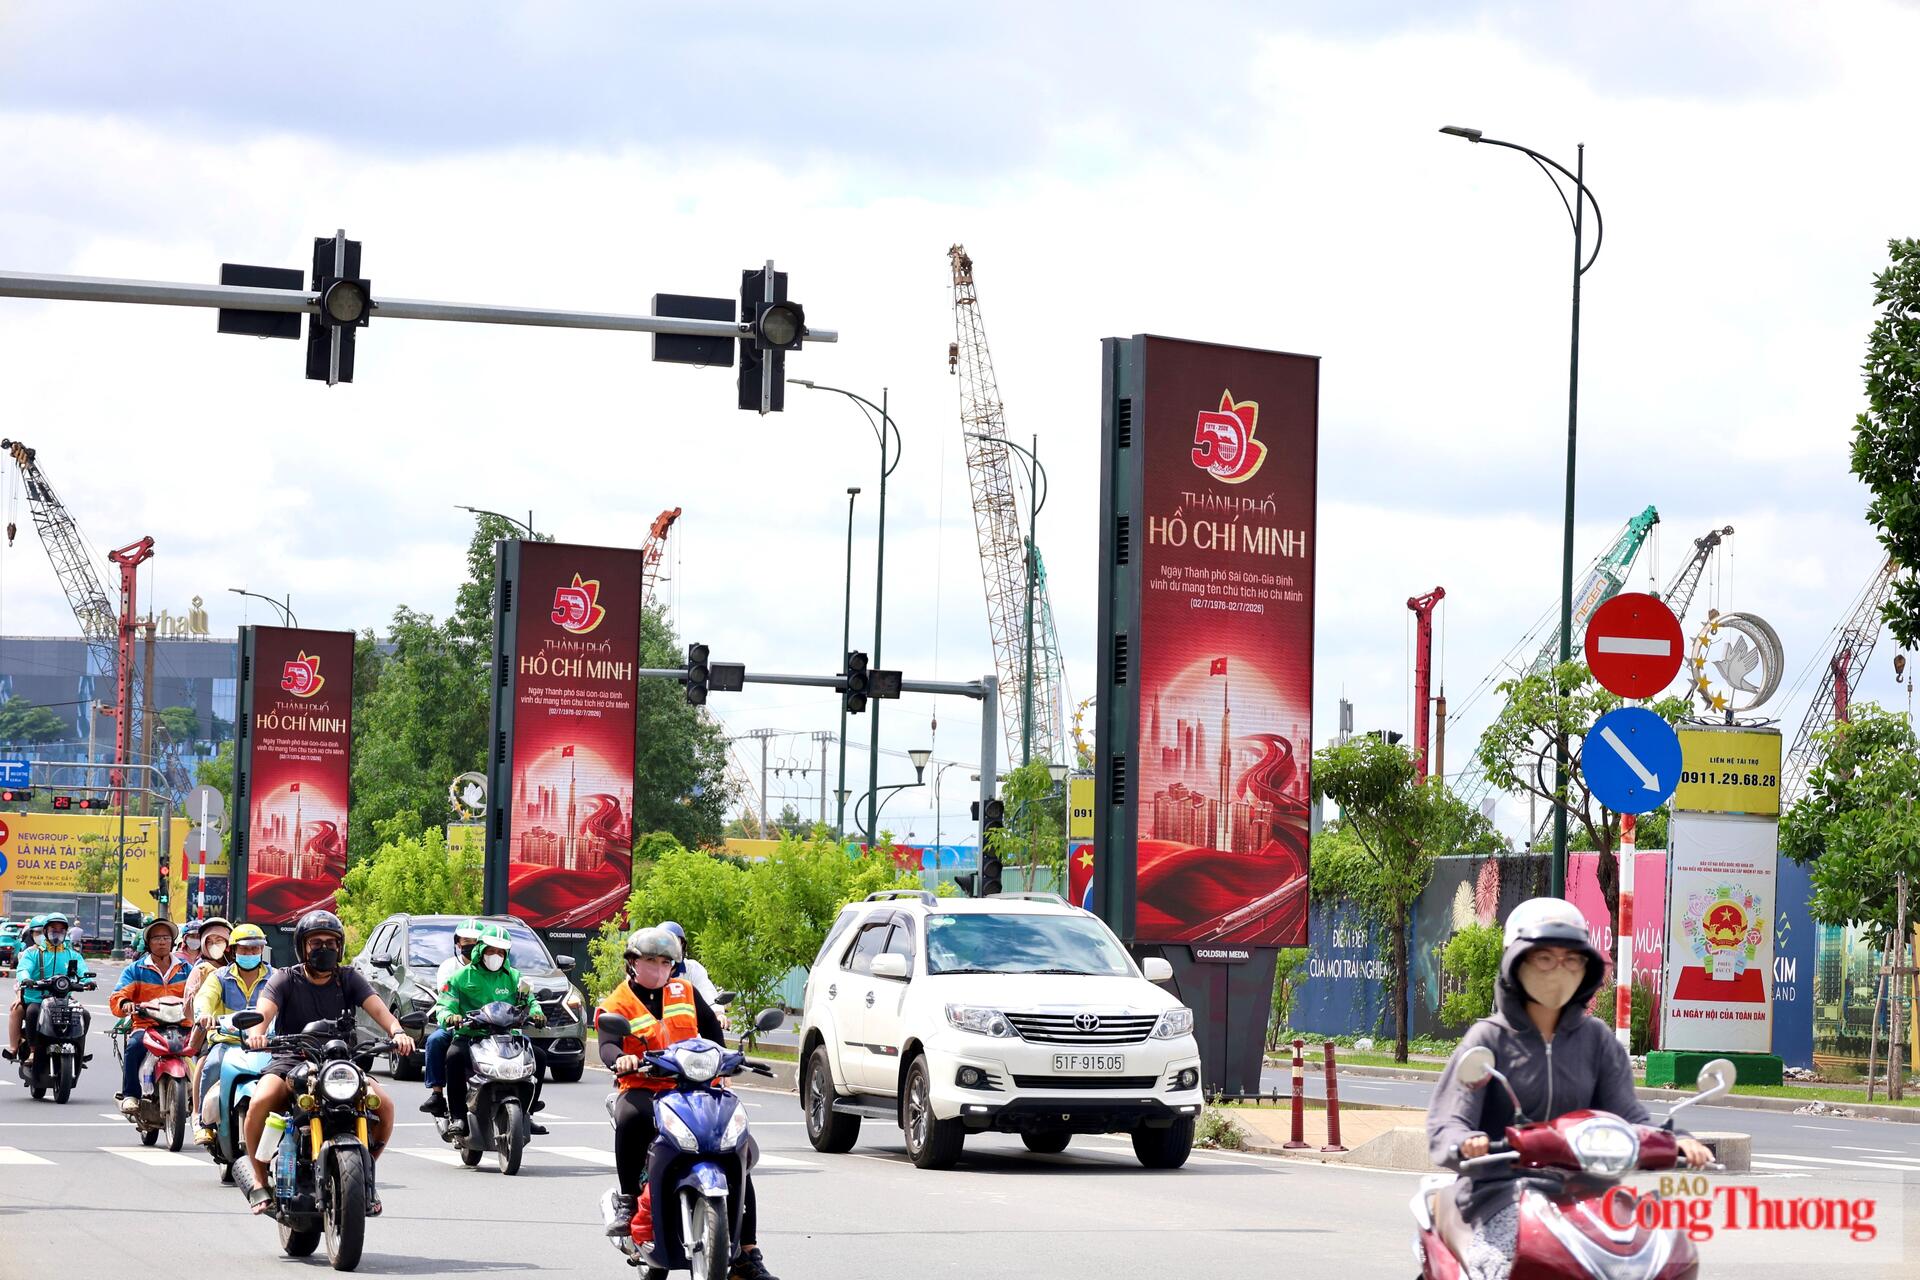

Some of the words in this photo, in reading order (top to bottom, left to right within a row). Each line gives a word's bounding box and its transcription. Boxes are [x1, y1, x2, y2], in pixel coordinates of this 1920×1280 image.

[1181, 488, 1239, 513] THÀNH
[1242, 492, 1276, 516] PHỐ
[1150, 506, 1187, 547] HỒ
[1193, 515, 1239, 551] CHÍ
[1243, 525, 1305, 558] MINH
[1275, 575, 1293, 587] Định
[1182, 583, 1205, 596] mang
[1284, 590, 1303, 602] Minh
[544, 637, 585, 652] THÀNH
[586, 639, 611, 655] PHỐ
[520, 649, 547, 675] HỒ
[552, 654, 585, 678] CHÍ
[586, 661, 632, 681] MINH
[257, 709, 279, 729] HỒ
[281, 712, 308, 731] CHÍ
[309, 717, 346, 733] MINH
[1681, 771, 1776, 787] 0911.29.68.28
[18, 833, 68, 841] NEWGROUP
[18, 843, 31, 854] LÀ
[34, 844, 57, 855] NHÀ
[60, 844, 76, 856] TÀI
[17, 860, 40, 869] ĐUA
[44, 860, 56, 869] XE
[60, 861, 82, 872] ĐẠP
[192, 904, 222, 917] NEW
[1635, 921, 1662, 953] MÙA
[1197, 949, 1227, 958] GOLDSUN
[1229, 950, 1249, 959] MEDIA
[1773, 987, 1796, 1001] AND
[1672, 1008, 1681, 1018] LÀ
[1683, 1009, 1703, 1018] NGÀY
[1705, 1009, 1717, 1020] HỘI
[1720, 1008, 1734, 1020] CỦA
[1735, 1010, 1752, 1020] TOÀN
[1055, 1056, 1122, 1070] 51F-915.05
